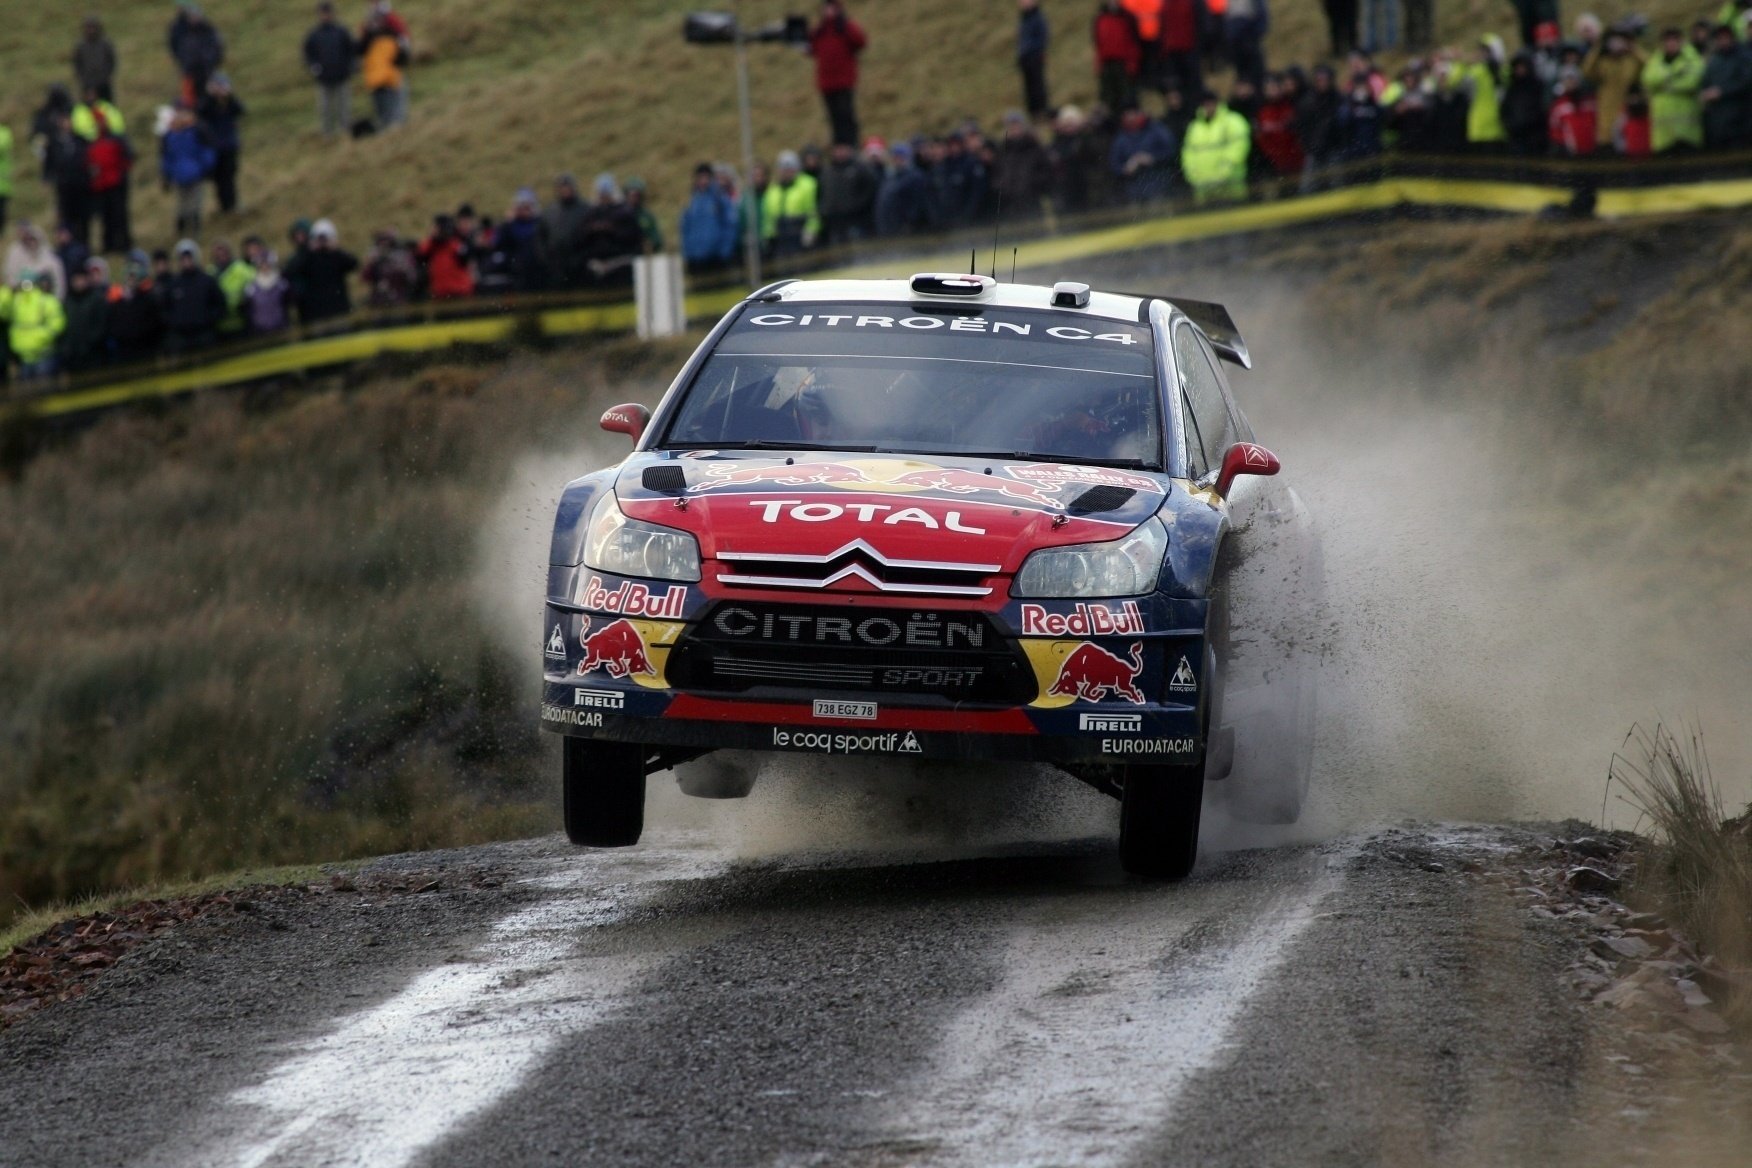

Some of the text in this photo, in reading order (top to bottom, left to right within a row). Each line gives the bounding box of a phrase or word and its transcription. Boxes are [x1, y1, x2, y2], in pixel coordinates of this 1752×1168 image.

[749, 313, 1139, 346] CITROËN C4
[603, 412, 630, 423] OTAL
[749, 500, 986, 536] TOTAL
[581, 576, 688, 619] Red Bull
[713, 607, 983, 647] CITROËN
[1021, 601, 1145, 636] Red Bull
[881, 667, 984, 687] SPORT
[575, 688, 625, 709] PIRELLI
[817, 704, 873, 716] 738 EGZ 78
[1079, 713, 1142, 732] PIRELLI
[773, 727, 898, 754] le coq sportif
[1102, 738, 1194, 754] EURODATACAR
